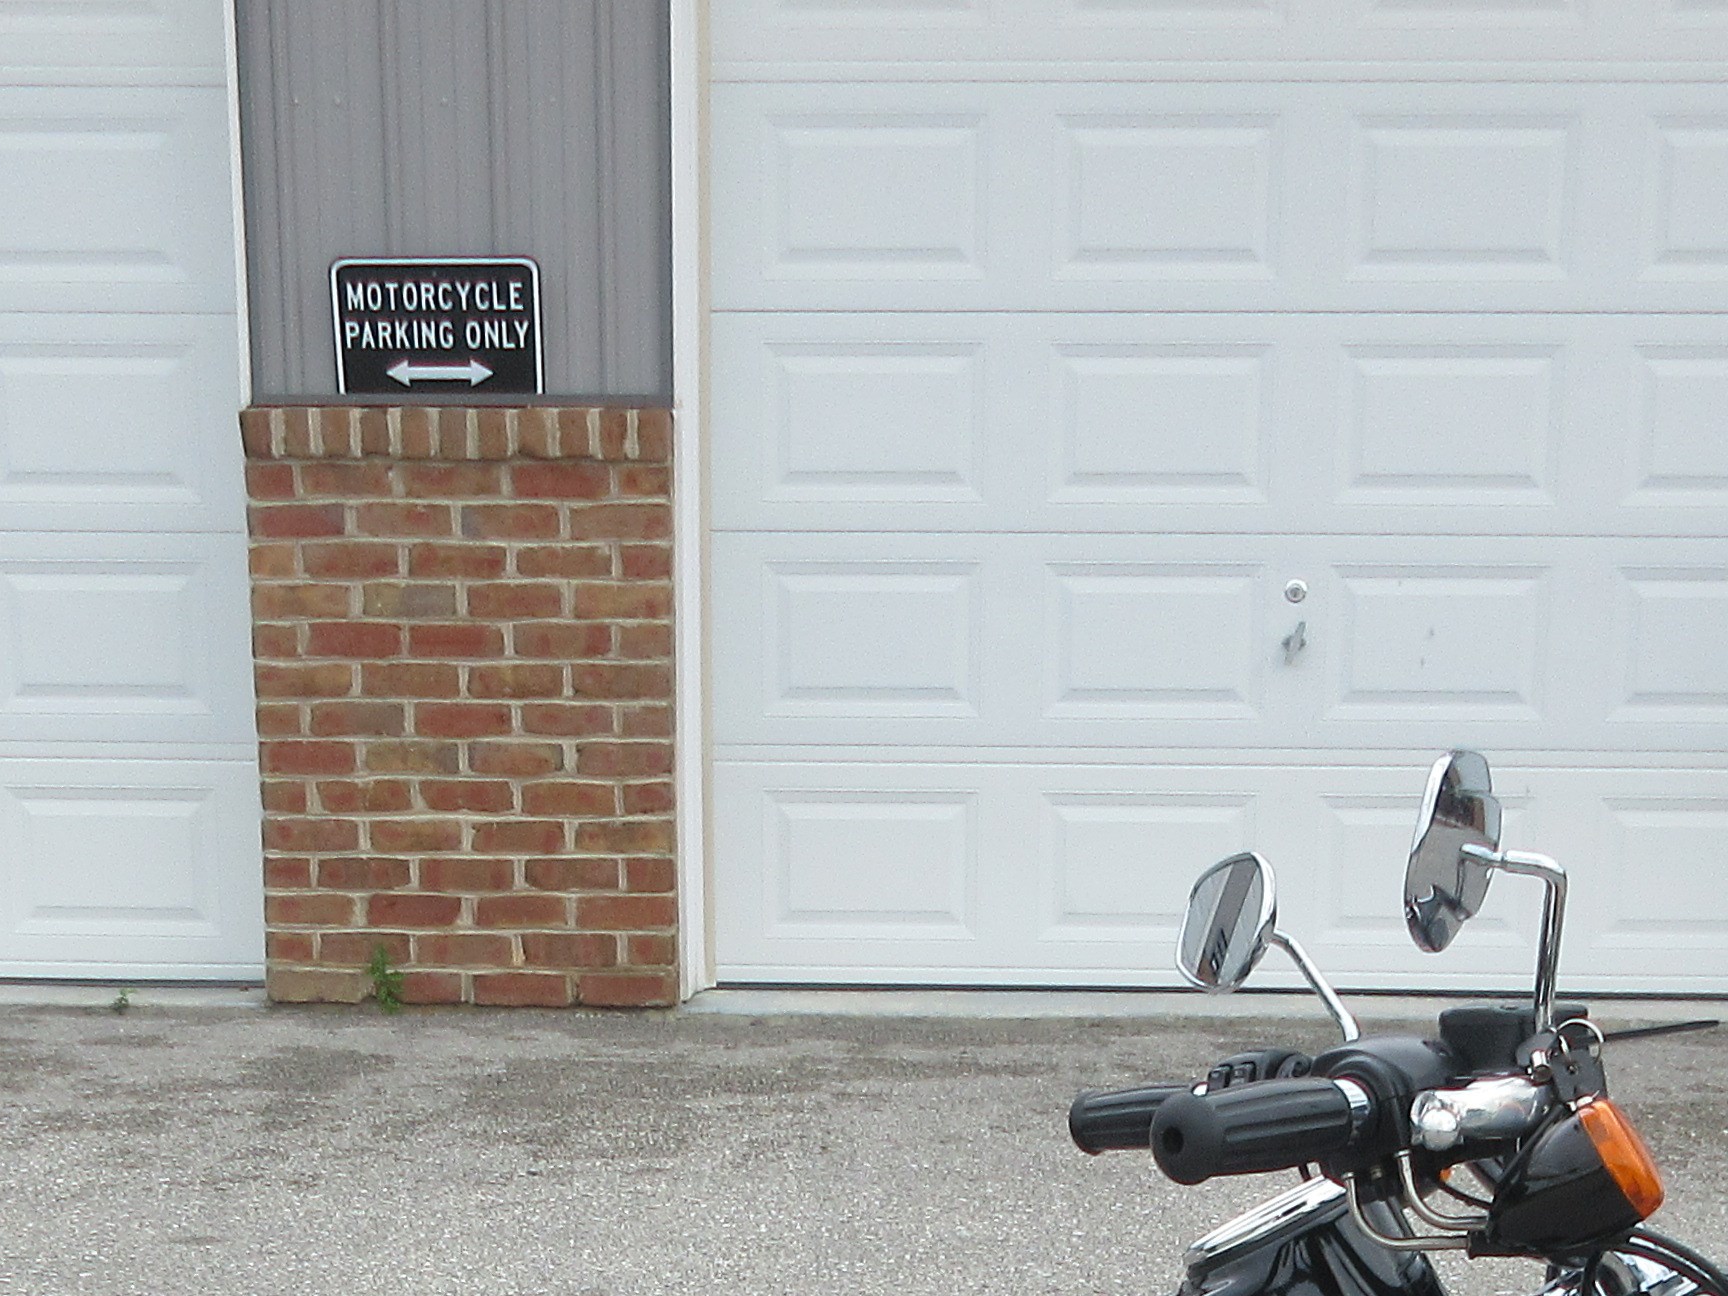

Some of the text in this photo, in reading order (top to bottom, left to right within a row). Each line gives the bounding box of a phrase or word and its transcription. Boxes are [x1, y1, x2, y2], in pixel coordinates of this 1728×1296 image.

[346, 281, 524, 312] MOTORCYCLE
[345, 320, 529, 350] PARKING ONLY
